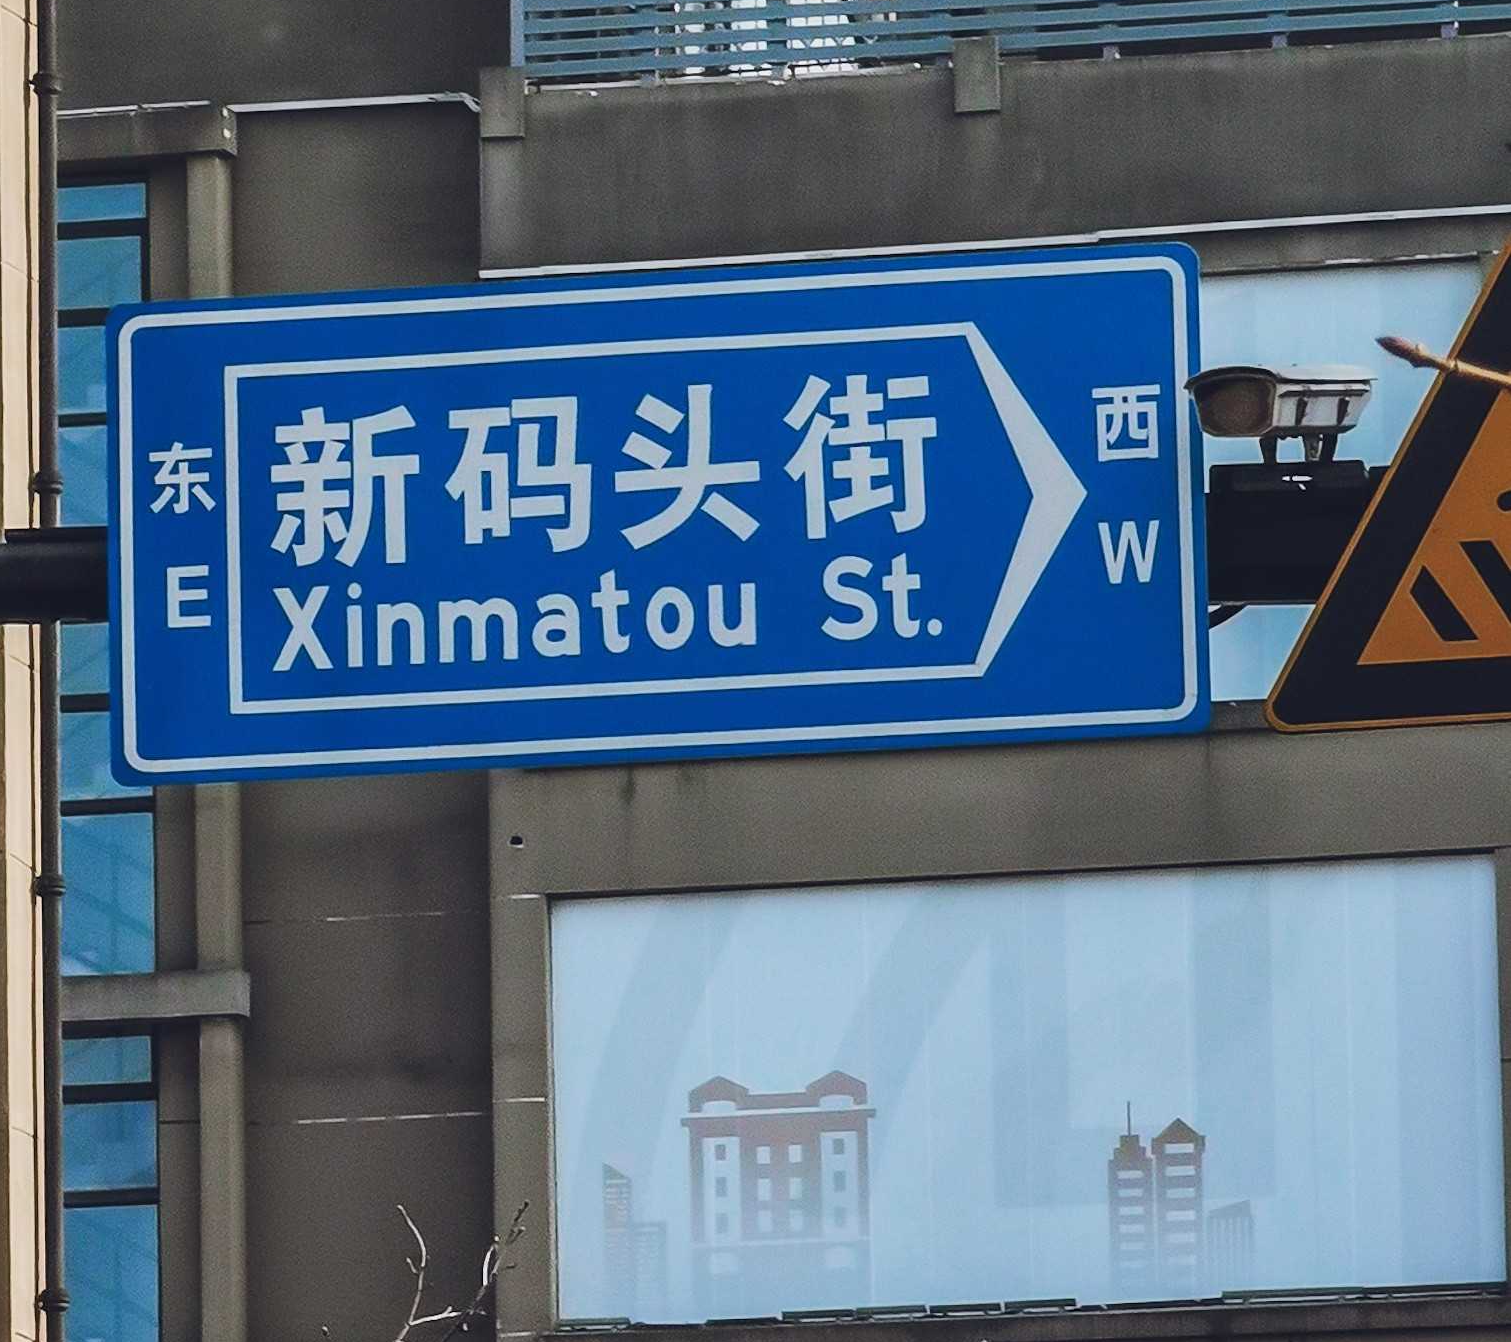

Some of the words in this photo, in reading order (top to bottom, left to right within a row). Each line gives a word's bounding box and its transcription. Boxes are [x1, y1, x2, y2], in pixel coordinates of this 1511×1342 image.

[1092, 384, 1161, 462] 西
[149, 442, 217, 514] 东
[271, 374, 938, 568] 新码头街
[1098, 520, 1160, 584] W
[166, 564, 212, 628] E
[273, 571, 757, 671] Xinmatou
[821, 553, 943, 641] St.
